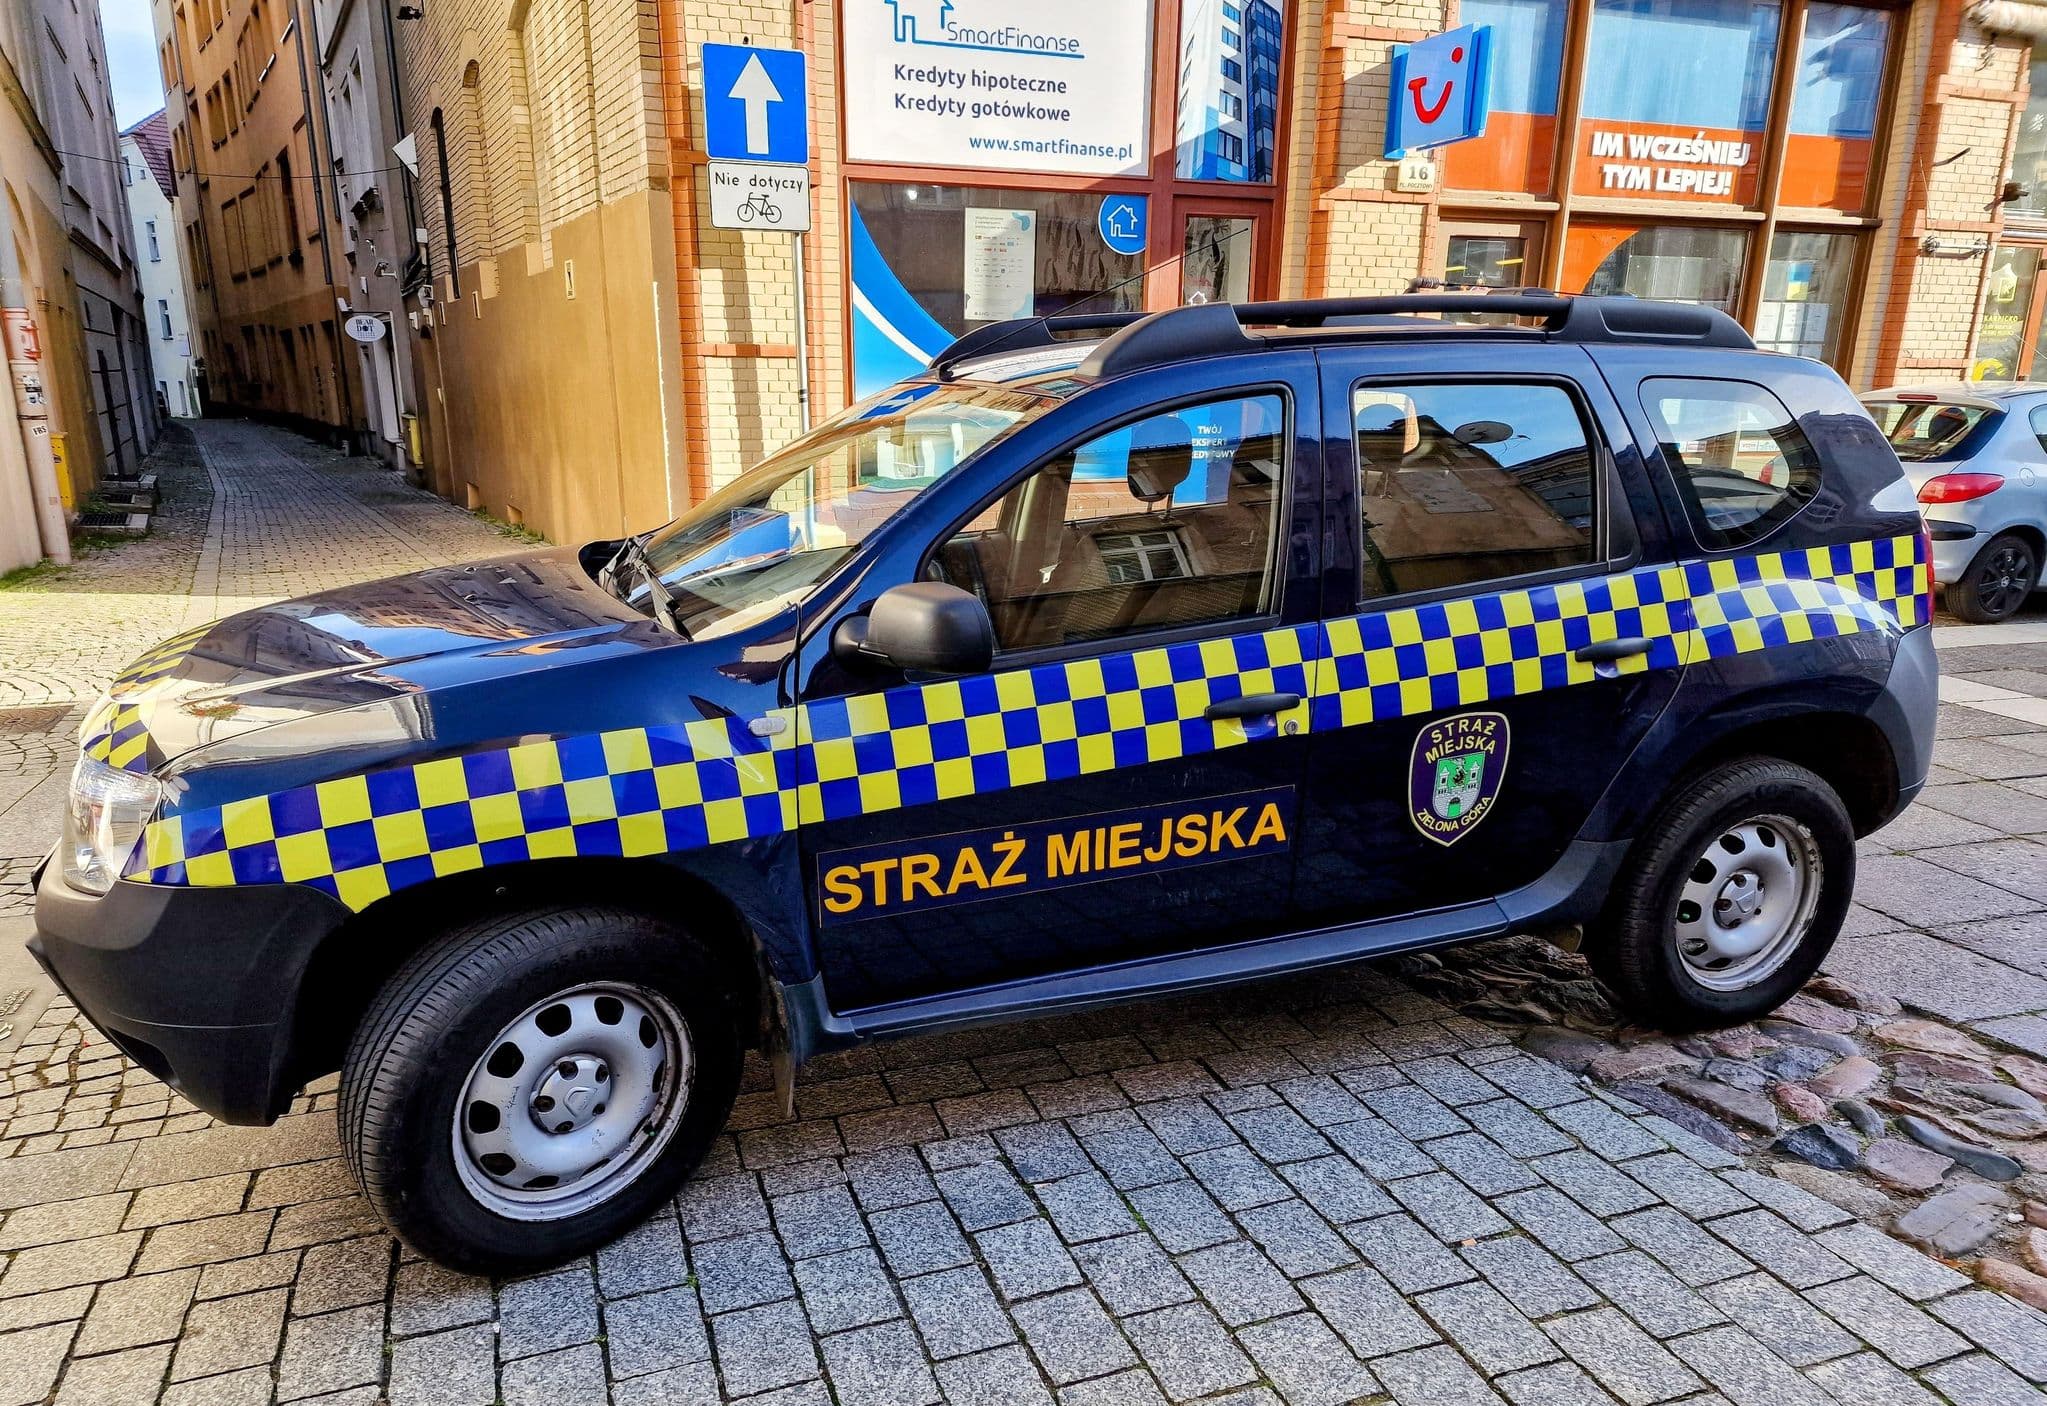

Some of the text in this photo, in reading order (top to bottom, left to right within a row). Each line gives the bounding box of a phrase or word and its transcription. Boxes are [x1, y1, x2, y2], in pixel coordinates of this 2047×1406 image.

[947, 21, 1080, 52] SmartFinanse
[894, 64, 1067, 94] Kredyty hipoteczne
[894, 93, 1071, 121] Kredyty gotówkowe
[969, 137, 1133, 160] www.smartfinanse.pl
[1592, 131, 1751, 167] IM WCZEŚNIEJ
[714, 171, 803, 193] Nie dotyczy
[1409, 166, 1428, 180] 16
[1602, 163, 1733, 196] TYM LEPIEJ!
[1197, 424, 1222, 434] TWÓJ
[1425, 735, 1496, 764] MIEJSKA
[1417, 808, 1459, 832] ZIELONA
[823, 803, 1287, 913] STRAŻ MIEJSKA
